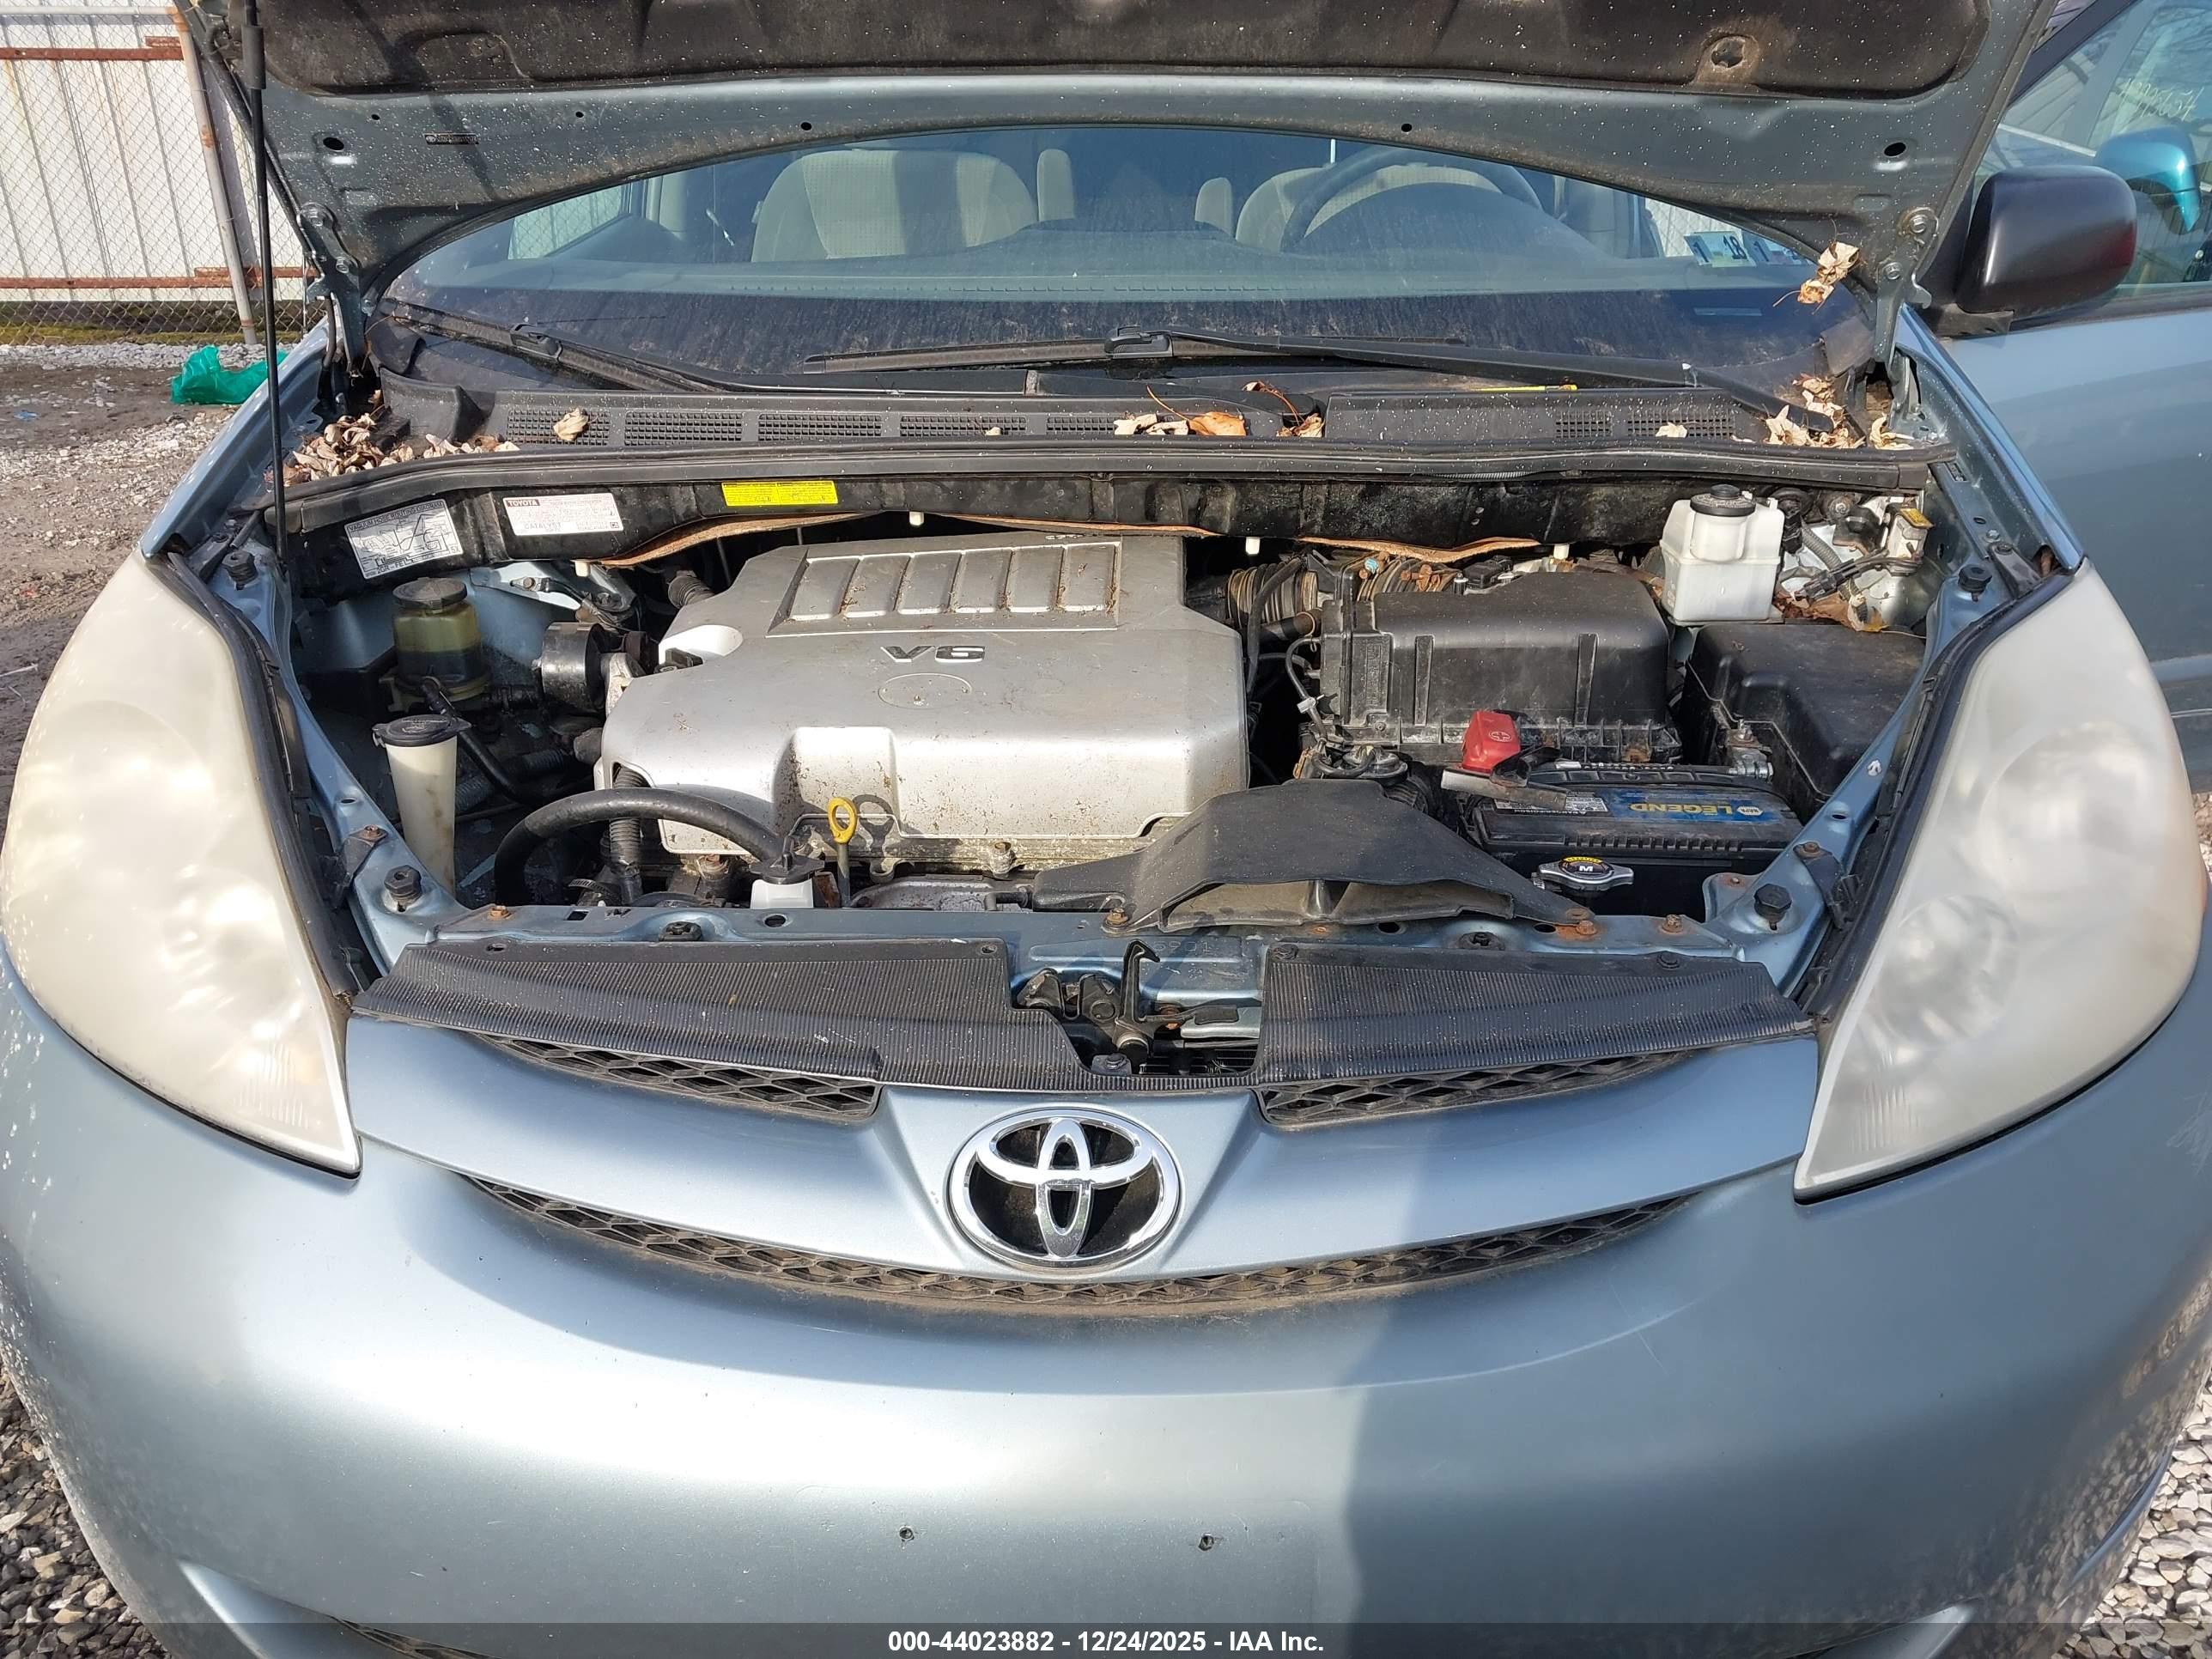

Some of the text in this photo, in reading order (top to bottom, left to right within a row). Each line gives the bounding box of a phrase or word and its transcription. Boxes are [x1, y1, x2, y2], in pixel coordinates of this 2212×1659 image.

[1723, 235, 1747, 259] 18
[349, 520, 374, 532] VACUUM
[378, 560, 404, 573] 2GR-FE
[880, 646, 985, 662] V6
[1629, 803, 1733, 815] LEGEND
